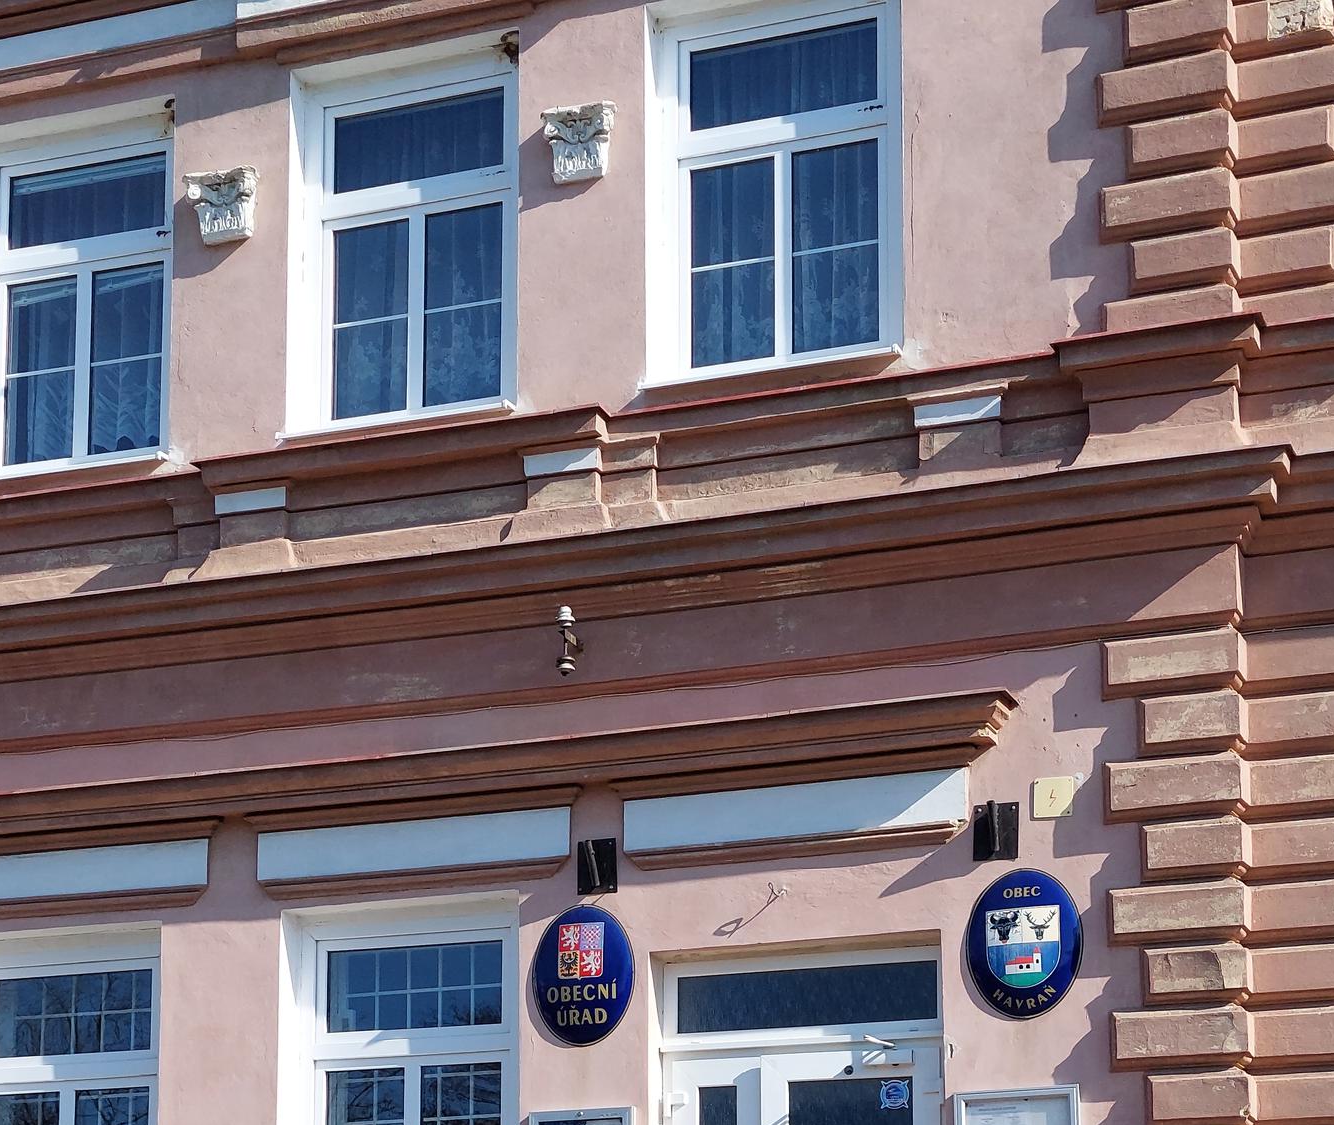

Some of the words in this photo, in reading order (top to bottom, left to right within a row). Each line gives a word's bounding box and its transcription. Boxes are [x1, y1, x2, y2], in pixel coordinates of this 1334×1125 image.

[1003, 886, 1041, 898] OBEC
[547, 978, 617, 1003] OBECNÍ
[992, 984, 1057, 1009] HAVRAŇ
[557, 1005, 608, 1026] ÚŘAD
